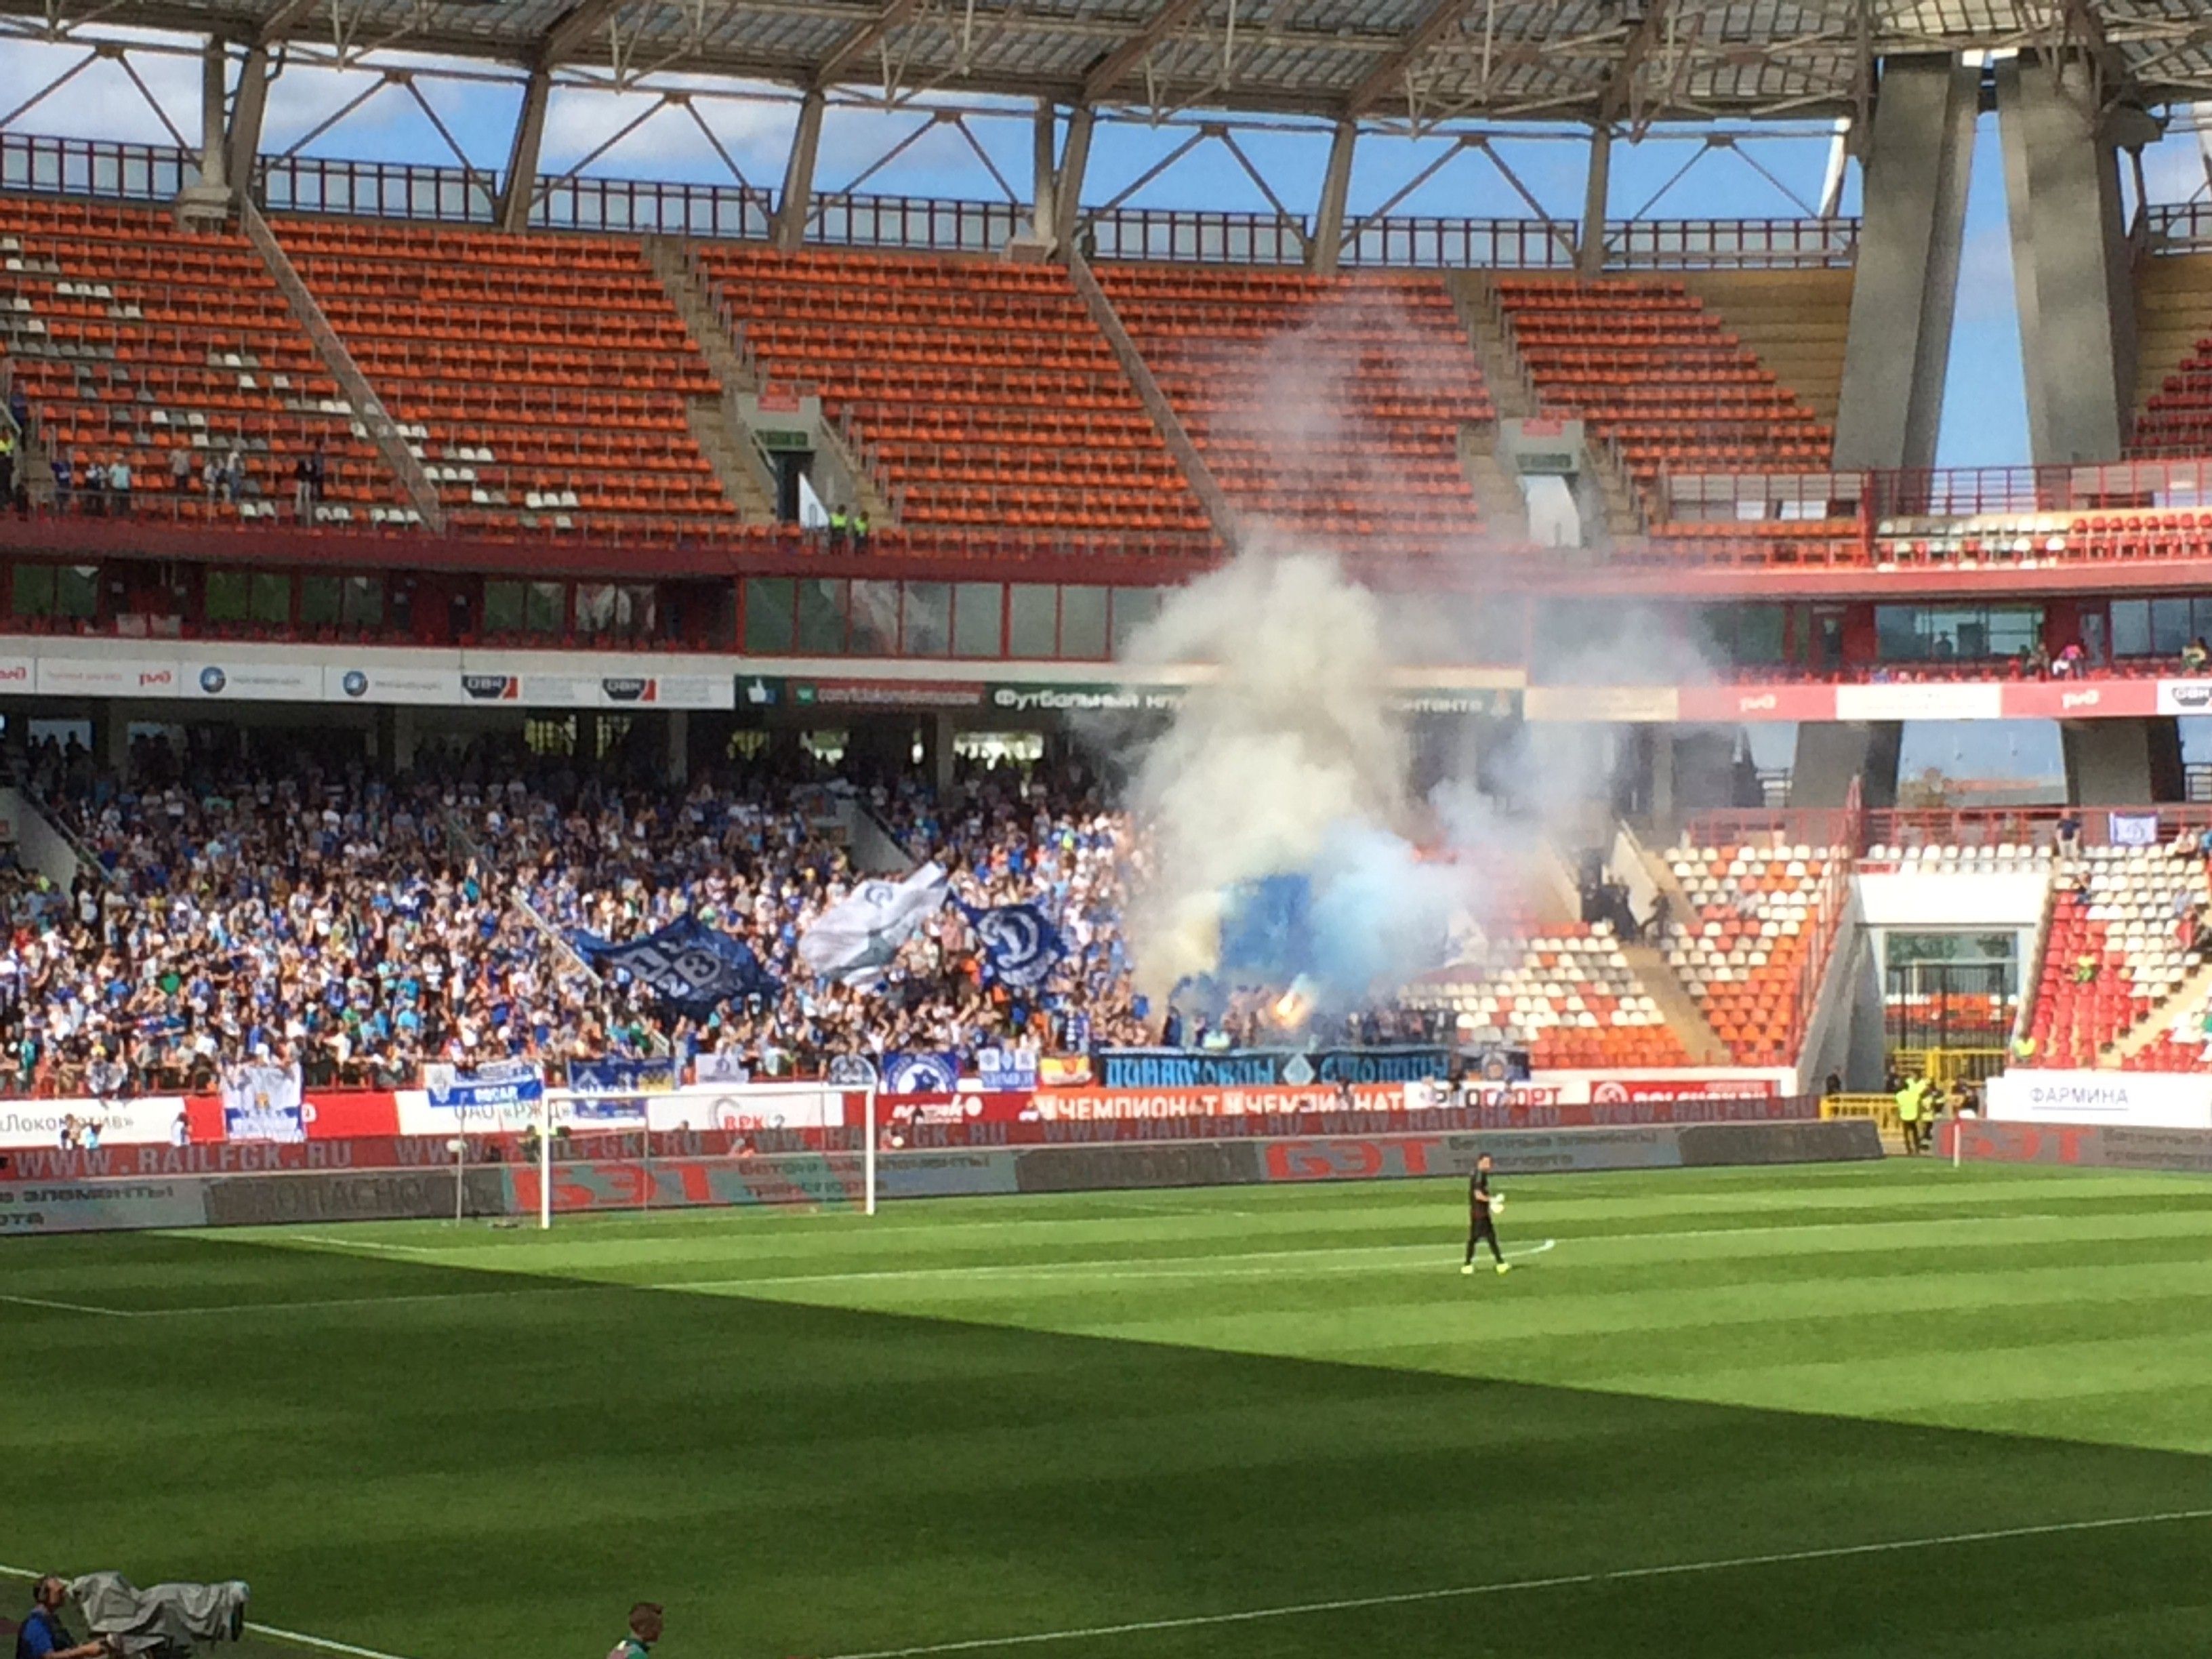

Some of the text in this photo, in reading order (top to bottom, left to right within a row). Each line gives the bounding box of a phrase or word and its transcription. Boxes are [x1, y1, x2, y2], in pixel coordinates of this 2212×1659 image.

[994, 689, 1139, 711] Футбольный
[1058, 1094, 1219, 1120] ЧЕМПИОНАТ
[2030, 1087, 2129, 1105] ФАРМИНА
[15, 1141, 352, 1178] WWW.RAILFGK.RU
[1265, 1136, 1443, 1179] БЭТ
